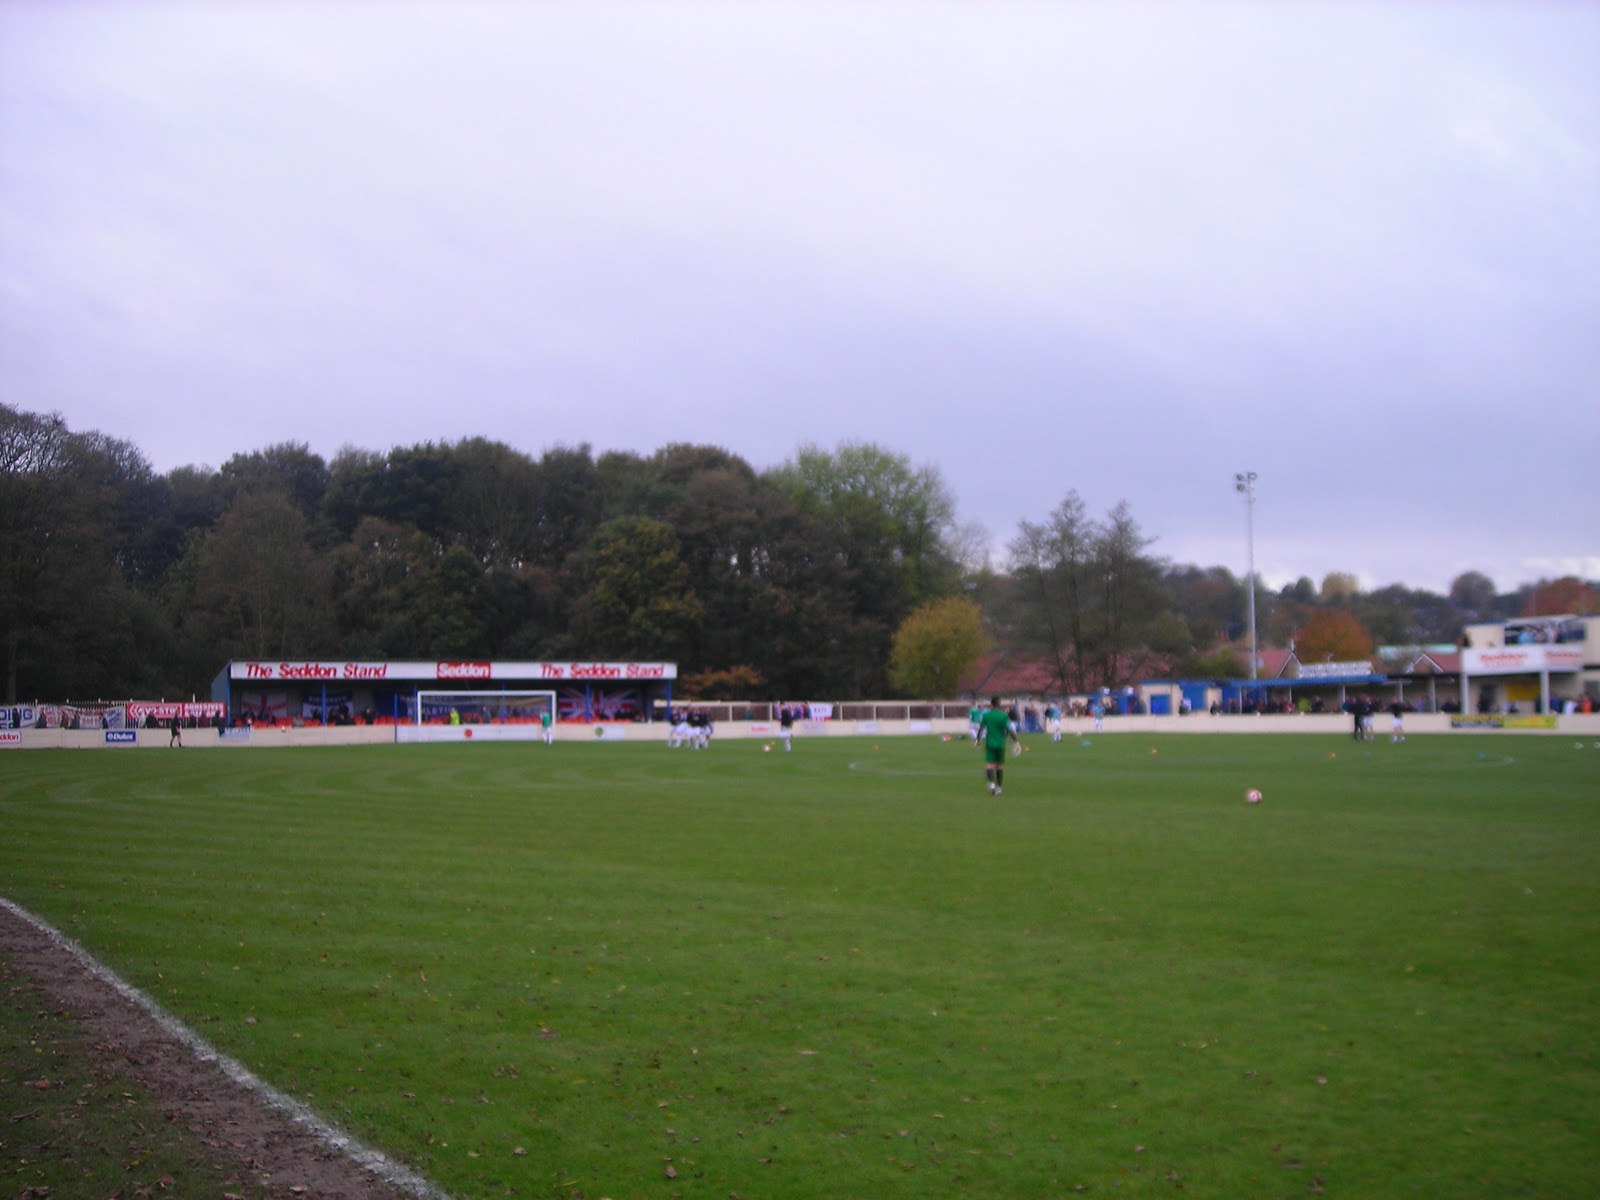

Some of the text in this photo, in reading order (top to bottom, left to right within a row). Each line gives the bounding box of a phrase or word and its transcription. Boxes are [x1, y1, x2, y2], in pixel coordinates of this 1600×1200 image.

[246, 662, 387, 678] The Seddon Stand
[437, 663, 489, 678] Seddon
[541, 663, 664, 678] The Seddon Stand
[113, 732, 134, 741] Dulux
